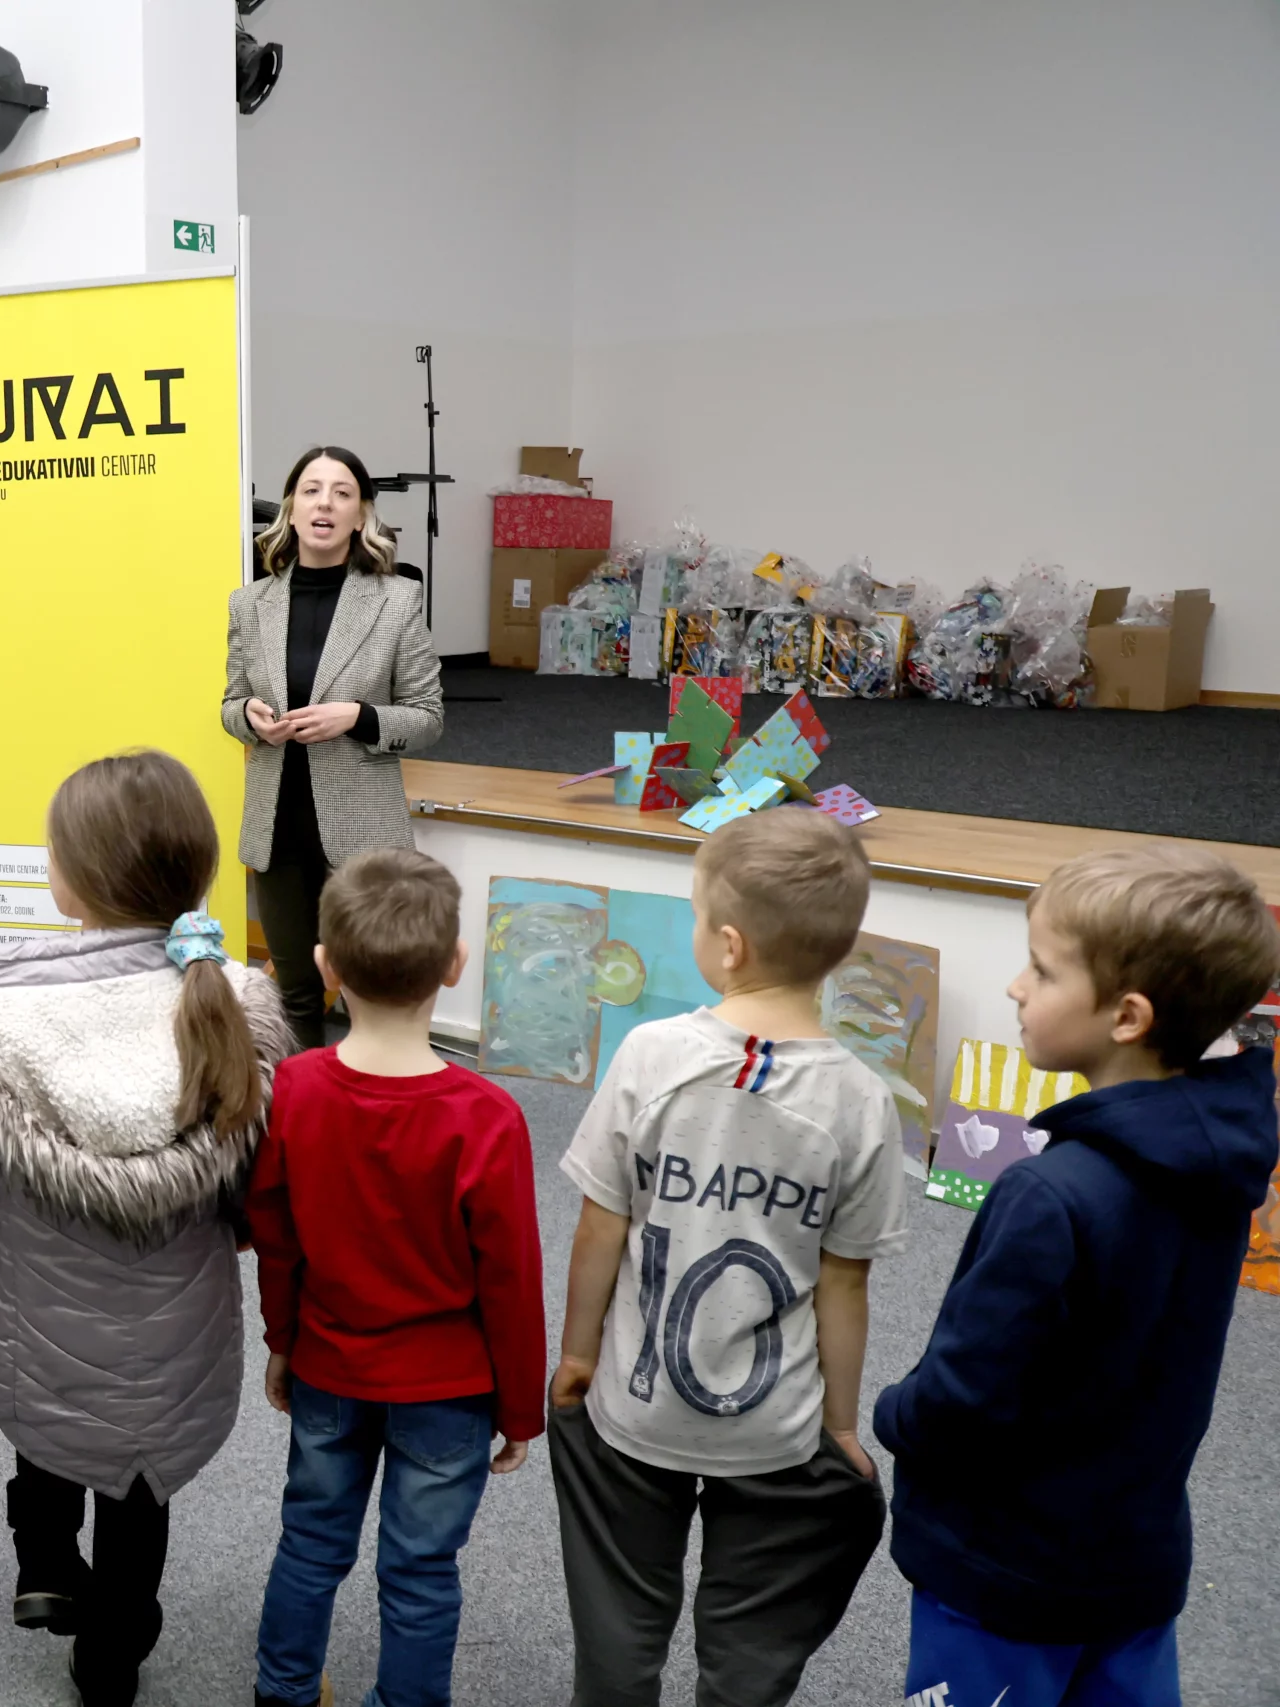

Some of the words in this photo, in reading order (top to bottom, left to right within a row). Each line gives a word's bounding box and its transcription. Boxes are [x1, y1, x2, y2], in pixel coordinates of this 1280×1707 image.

[101, 453, 157, 477] CENTAR
[16, 864, 39, 875] CENTAR
[14, 905, 36, 916] GODINE
[628, 1220, 798, 1417] 10
